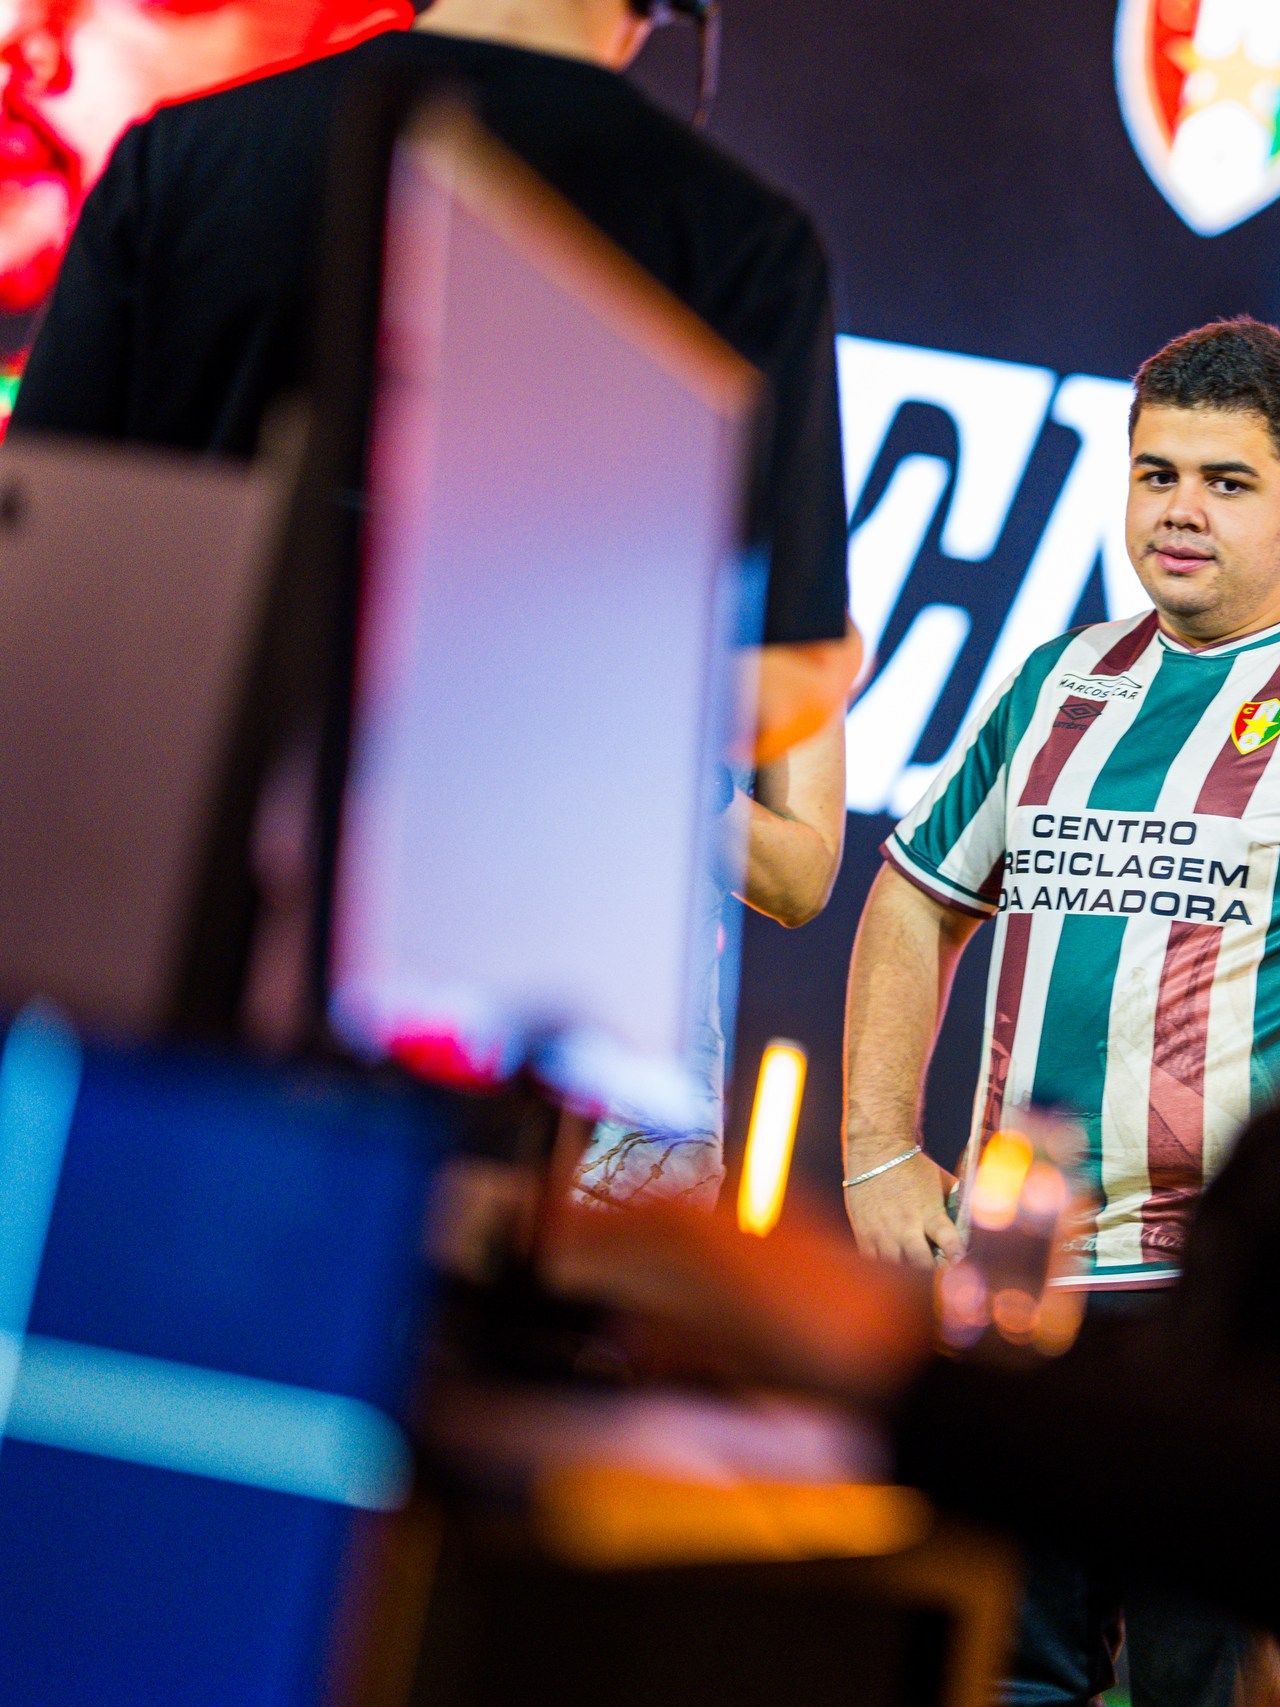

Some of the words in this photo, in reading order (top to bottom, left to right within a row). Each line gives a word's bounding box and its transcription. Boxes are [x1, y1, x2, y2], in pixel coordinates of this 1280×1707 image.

[1032, 814, 1197, 845] CENTRO
[1004, 849, 1250, 889] RECICLAGEM
[1031, 886, 1252, 926] AMADORA
